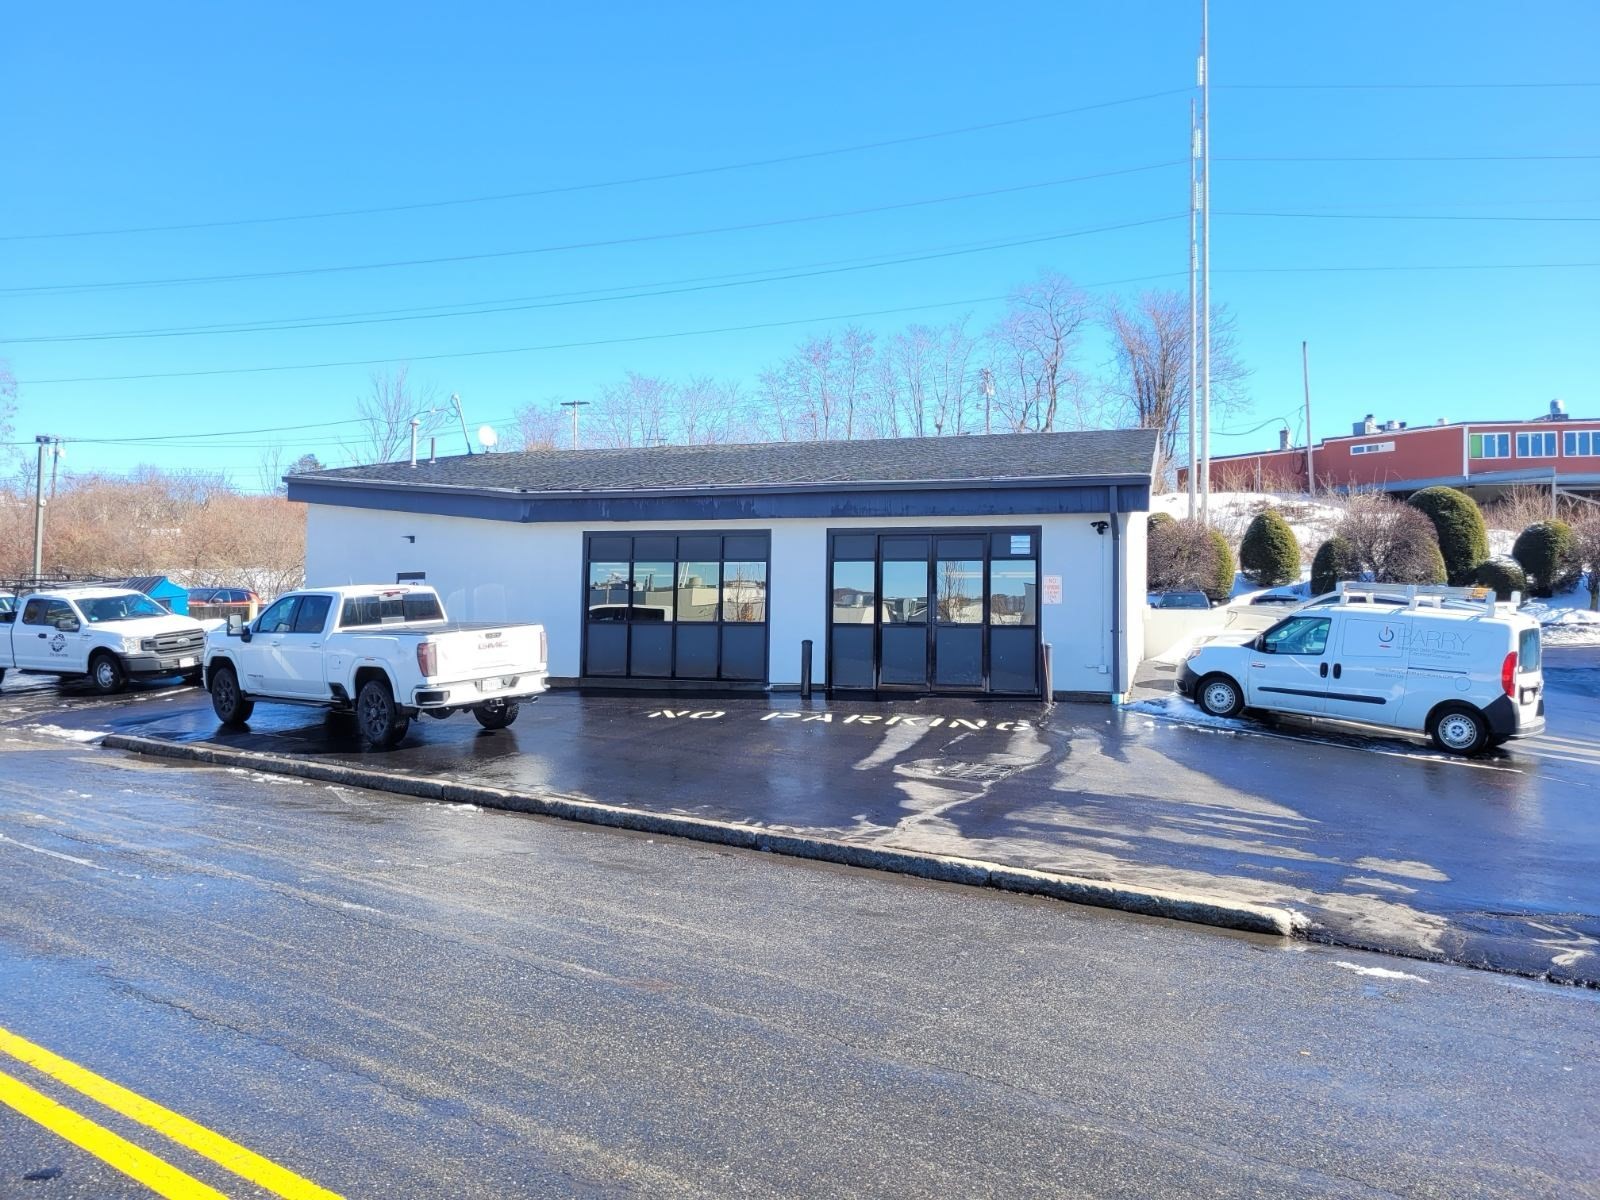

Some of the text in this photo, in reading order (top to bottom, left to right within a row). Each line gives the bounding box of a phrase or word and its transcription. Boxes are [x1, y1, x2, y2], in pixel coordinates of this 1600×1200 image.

[1398, 628, 1472, 650] BARRY
[648, 709, 1031, 731] NO PARKING
